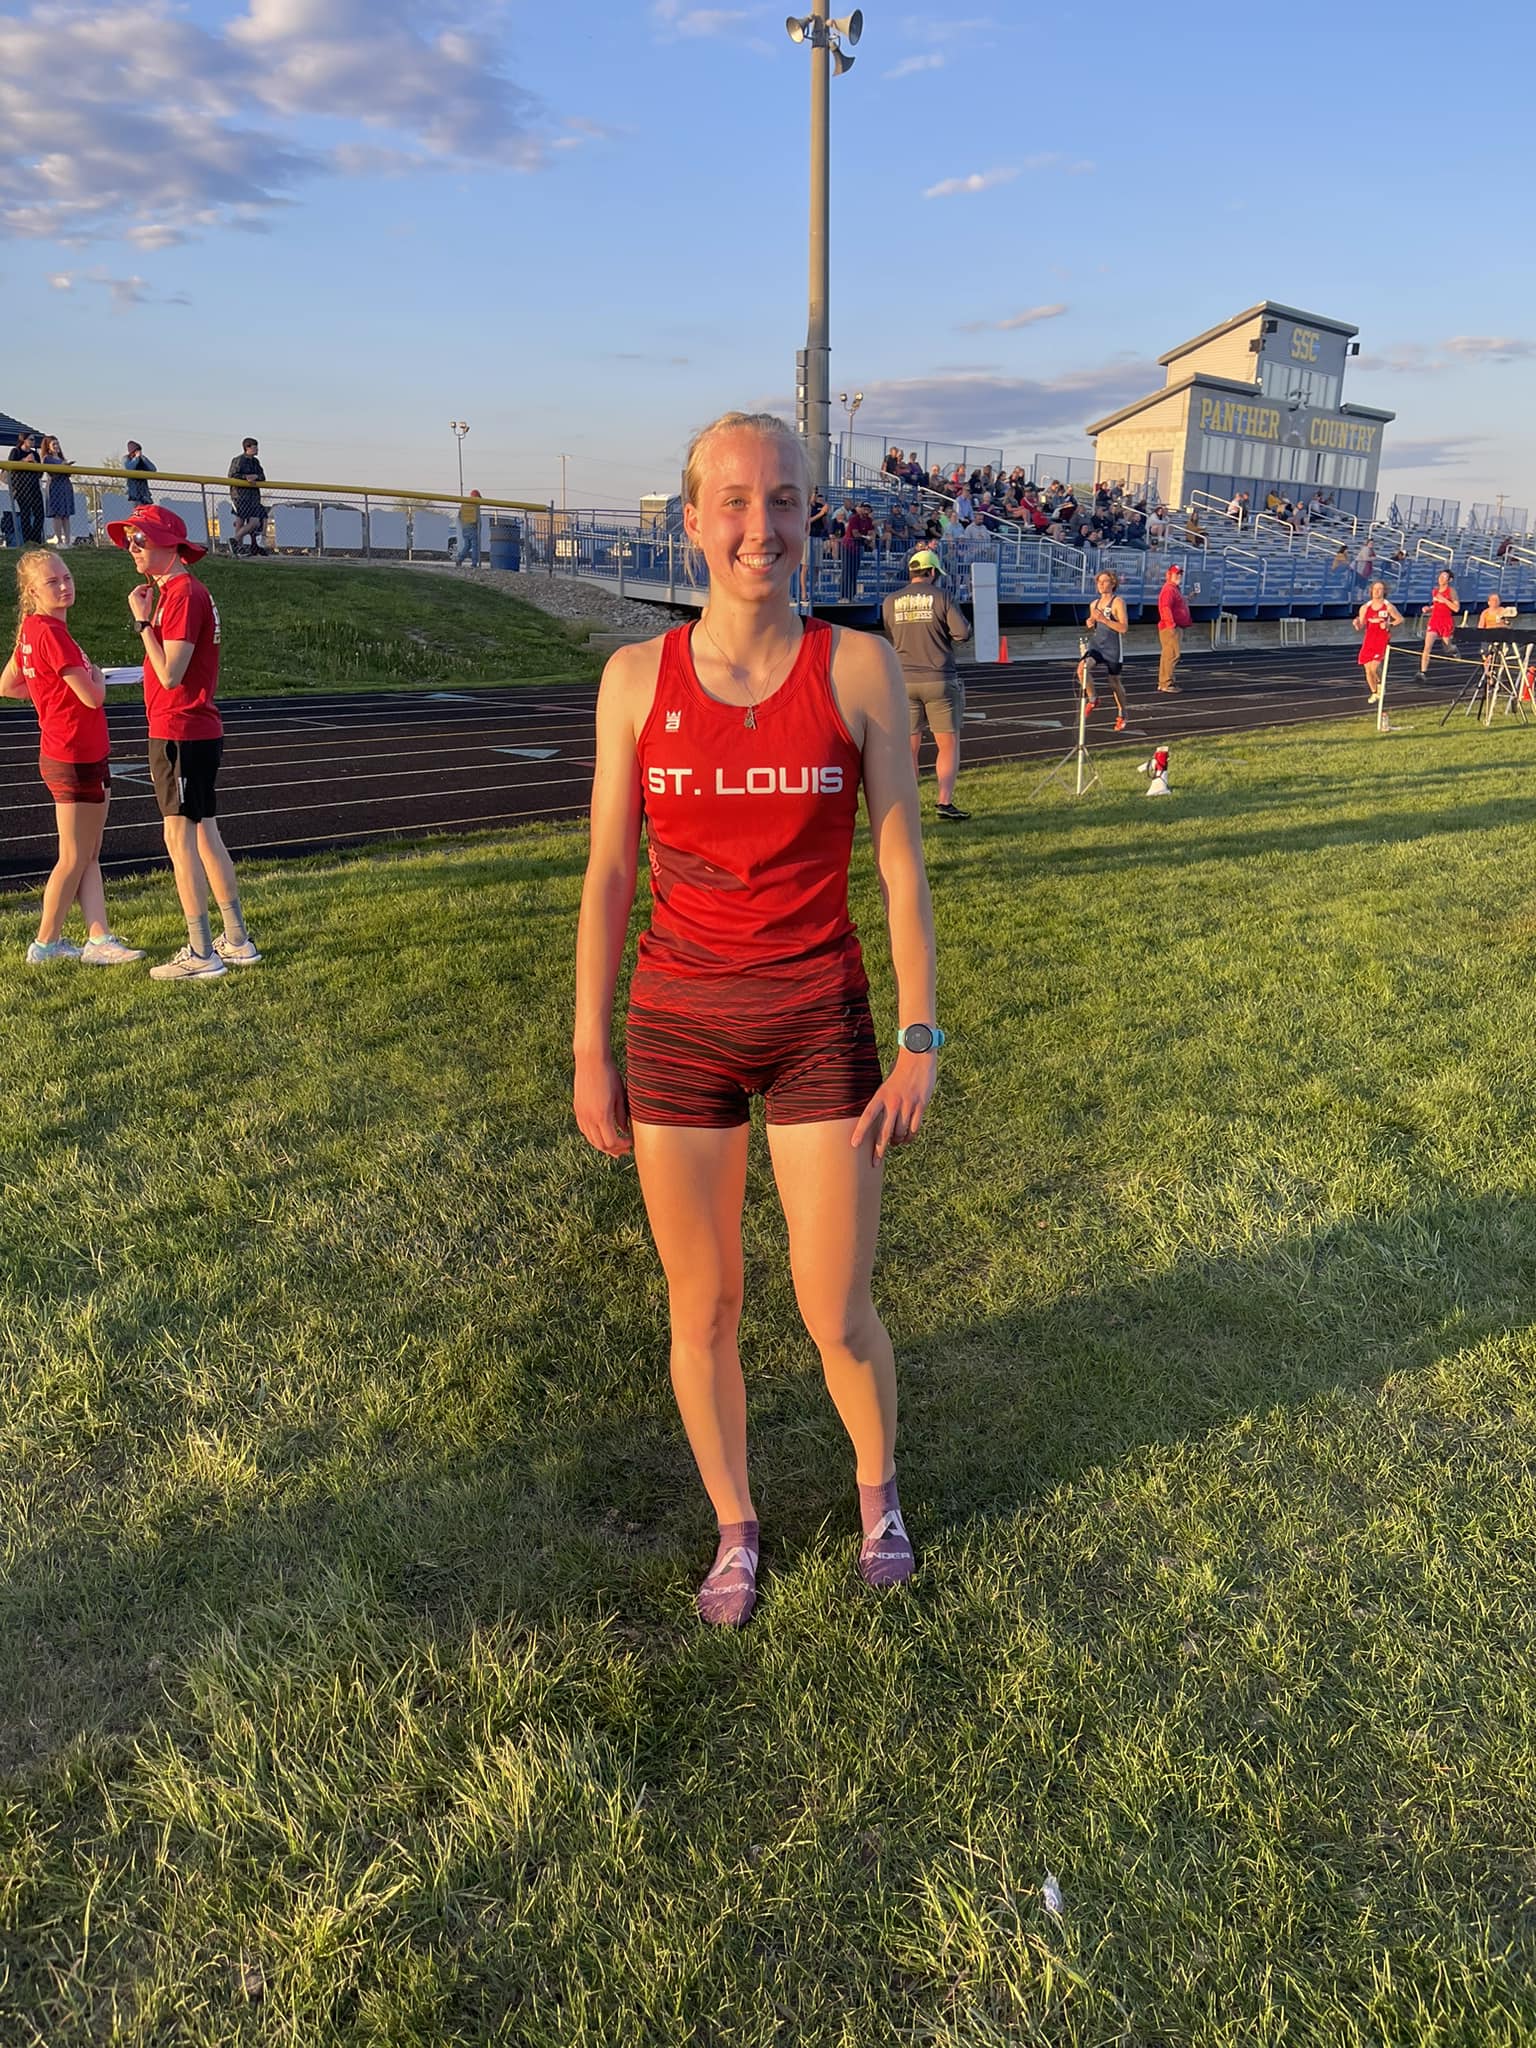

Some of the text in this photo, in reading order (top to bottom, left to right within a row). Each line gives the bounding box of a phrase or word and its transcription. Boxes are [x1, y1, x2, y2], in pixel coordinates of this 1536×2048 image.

[1291, 327, 1320, 362] SSC
[1200, 398, 1377, 452] PANTHER COUNTRY
[648, 767, 843, 795] ST. LOUIS
